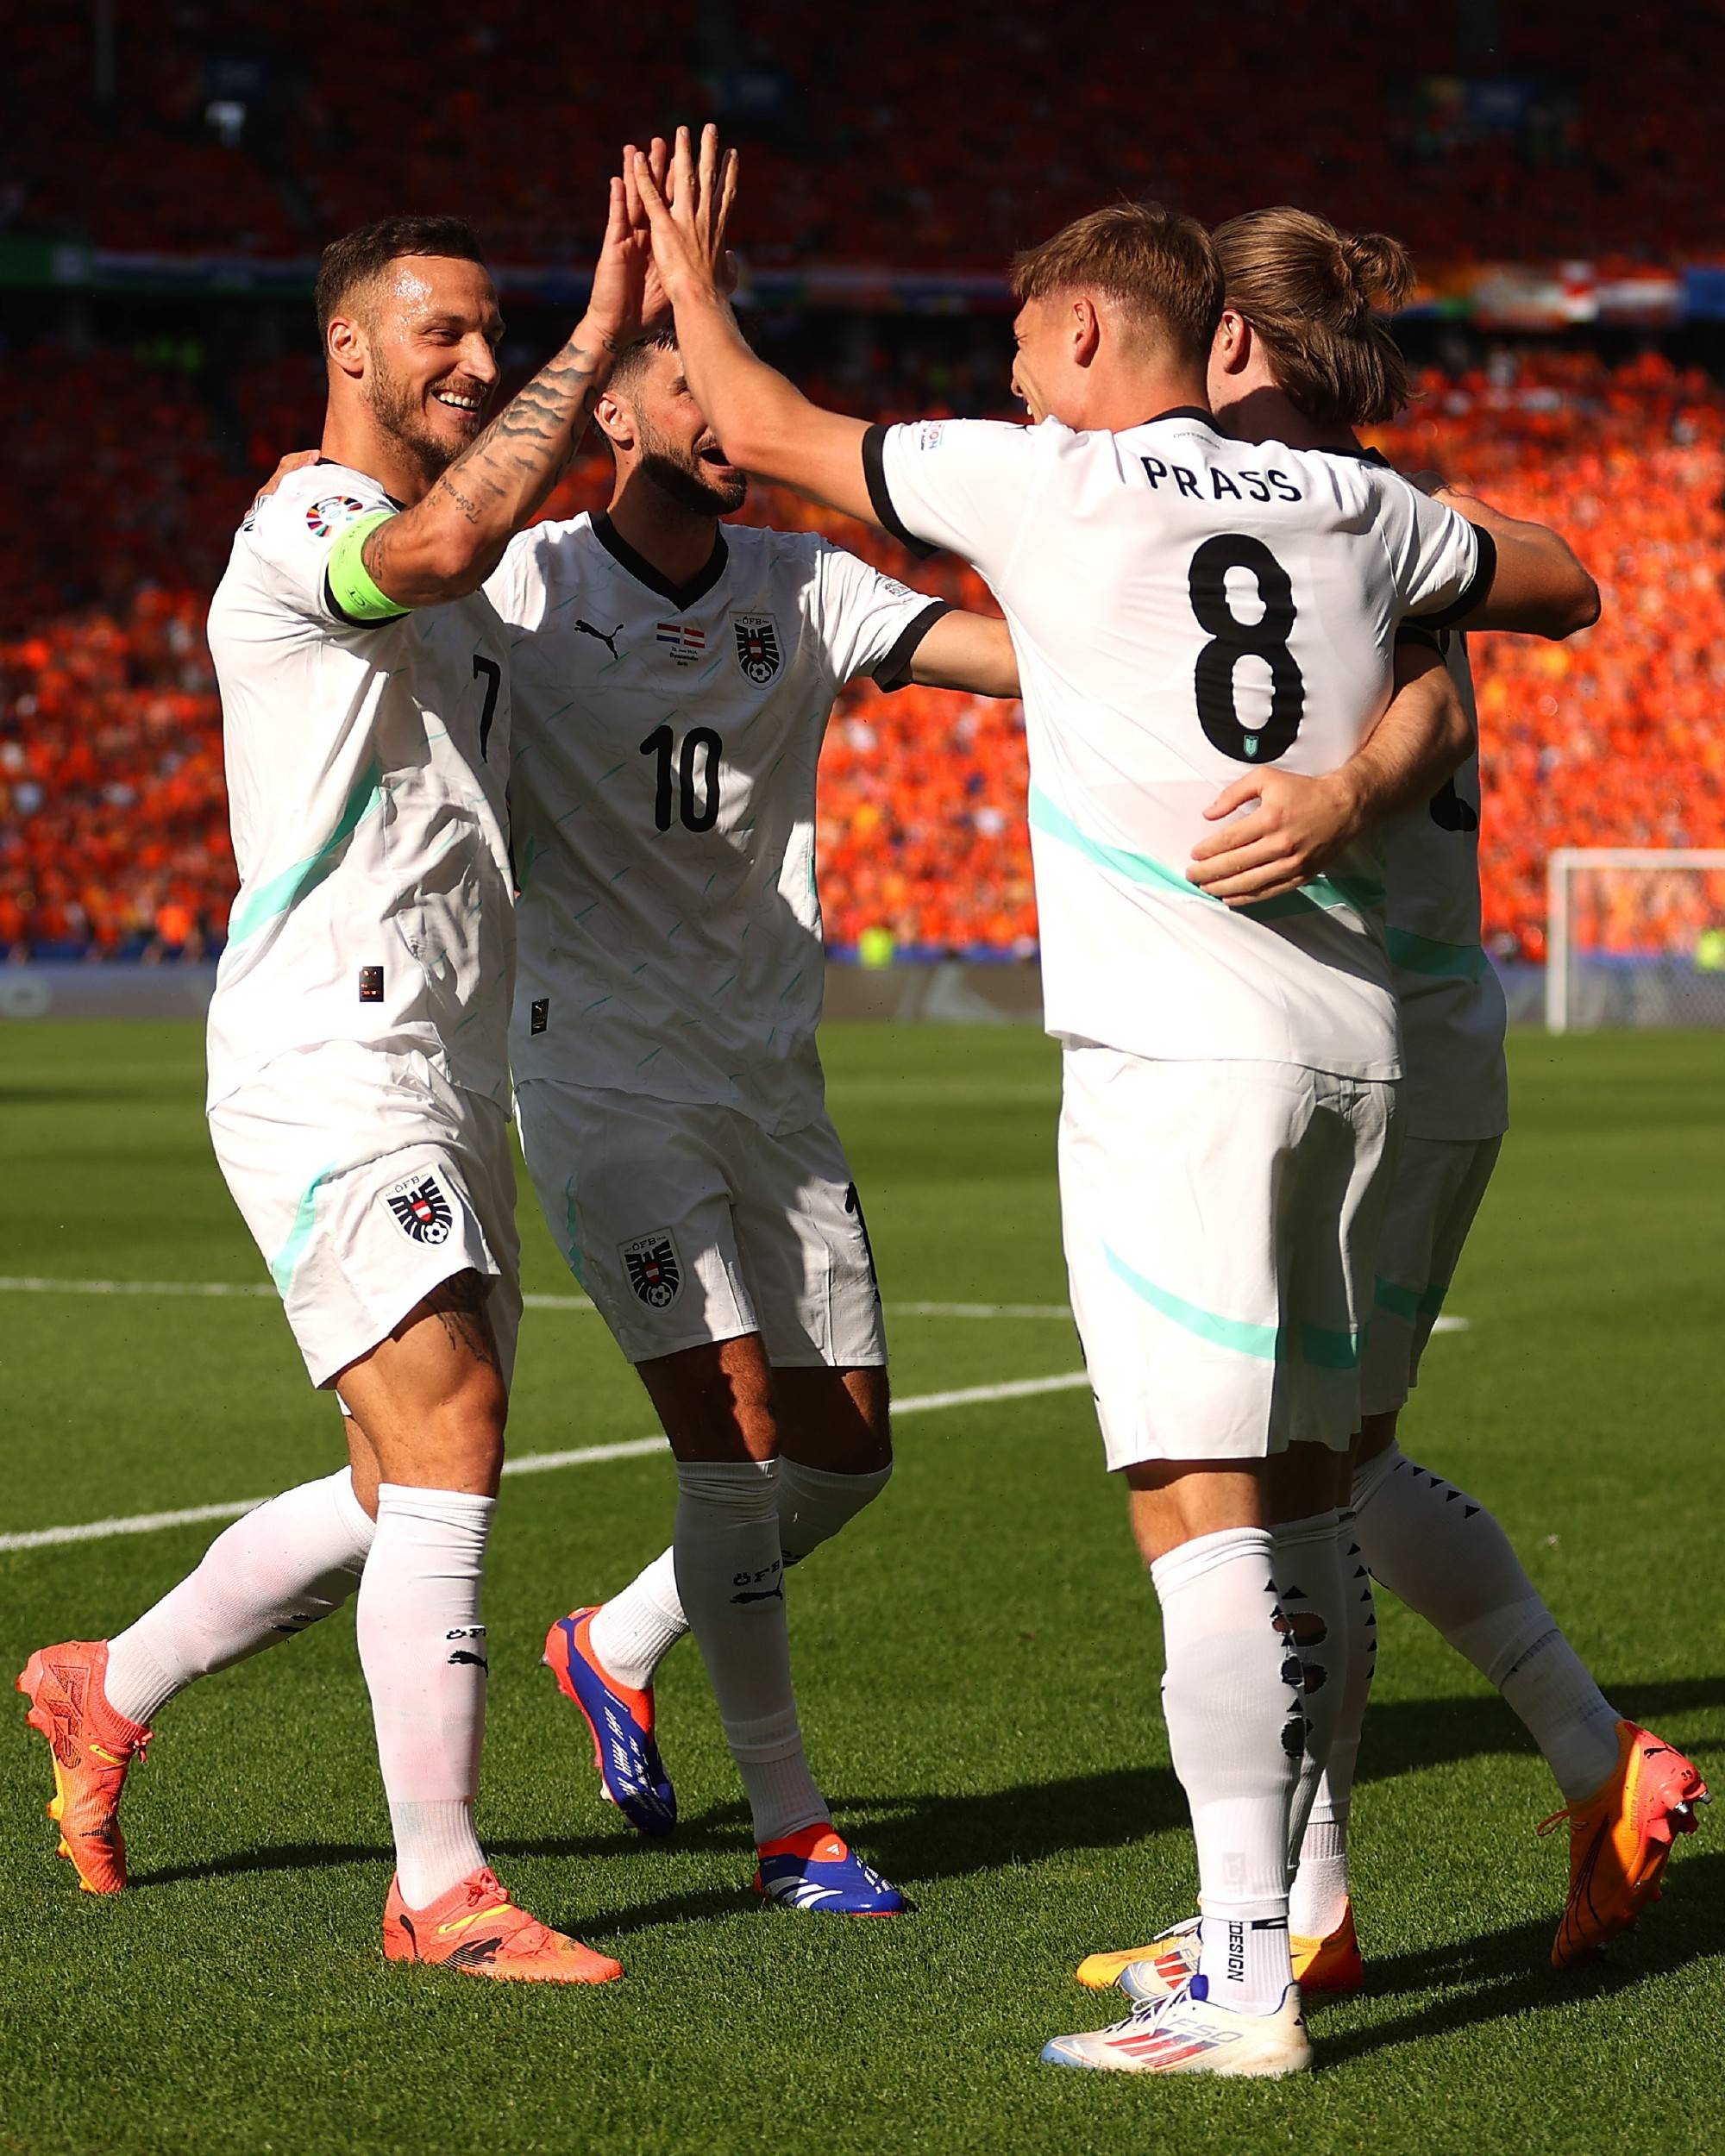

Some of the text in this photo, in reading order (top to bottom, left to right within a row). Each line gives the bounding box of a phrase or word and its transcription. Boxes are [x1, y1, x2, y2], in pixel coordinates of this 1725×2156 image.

[1140, 456, 1302, 502] PRASS
[1189, 533, 1305, 764] 8
[472, 654, 501, 764] 7
[639, 724, 723, 833] 10
[1167, 2018, 1244, 2043] F50
